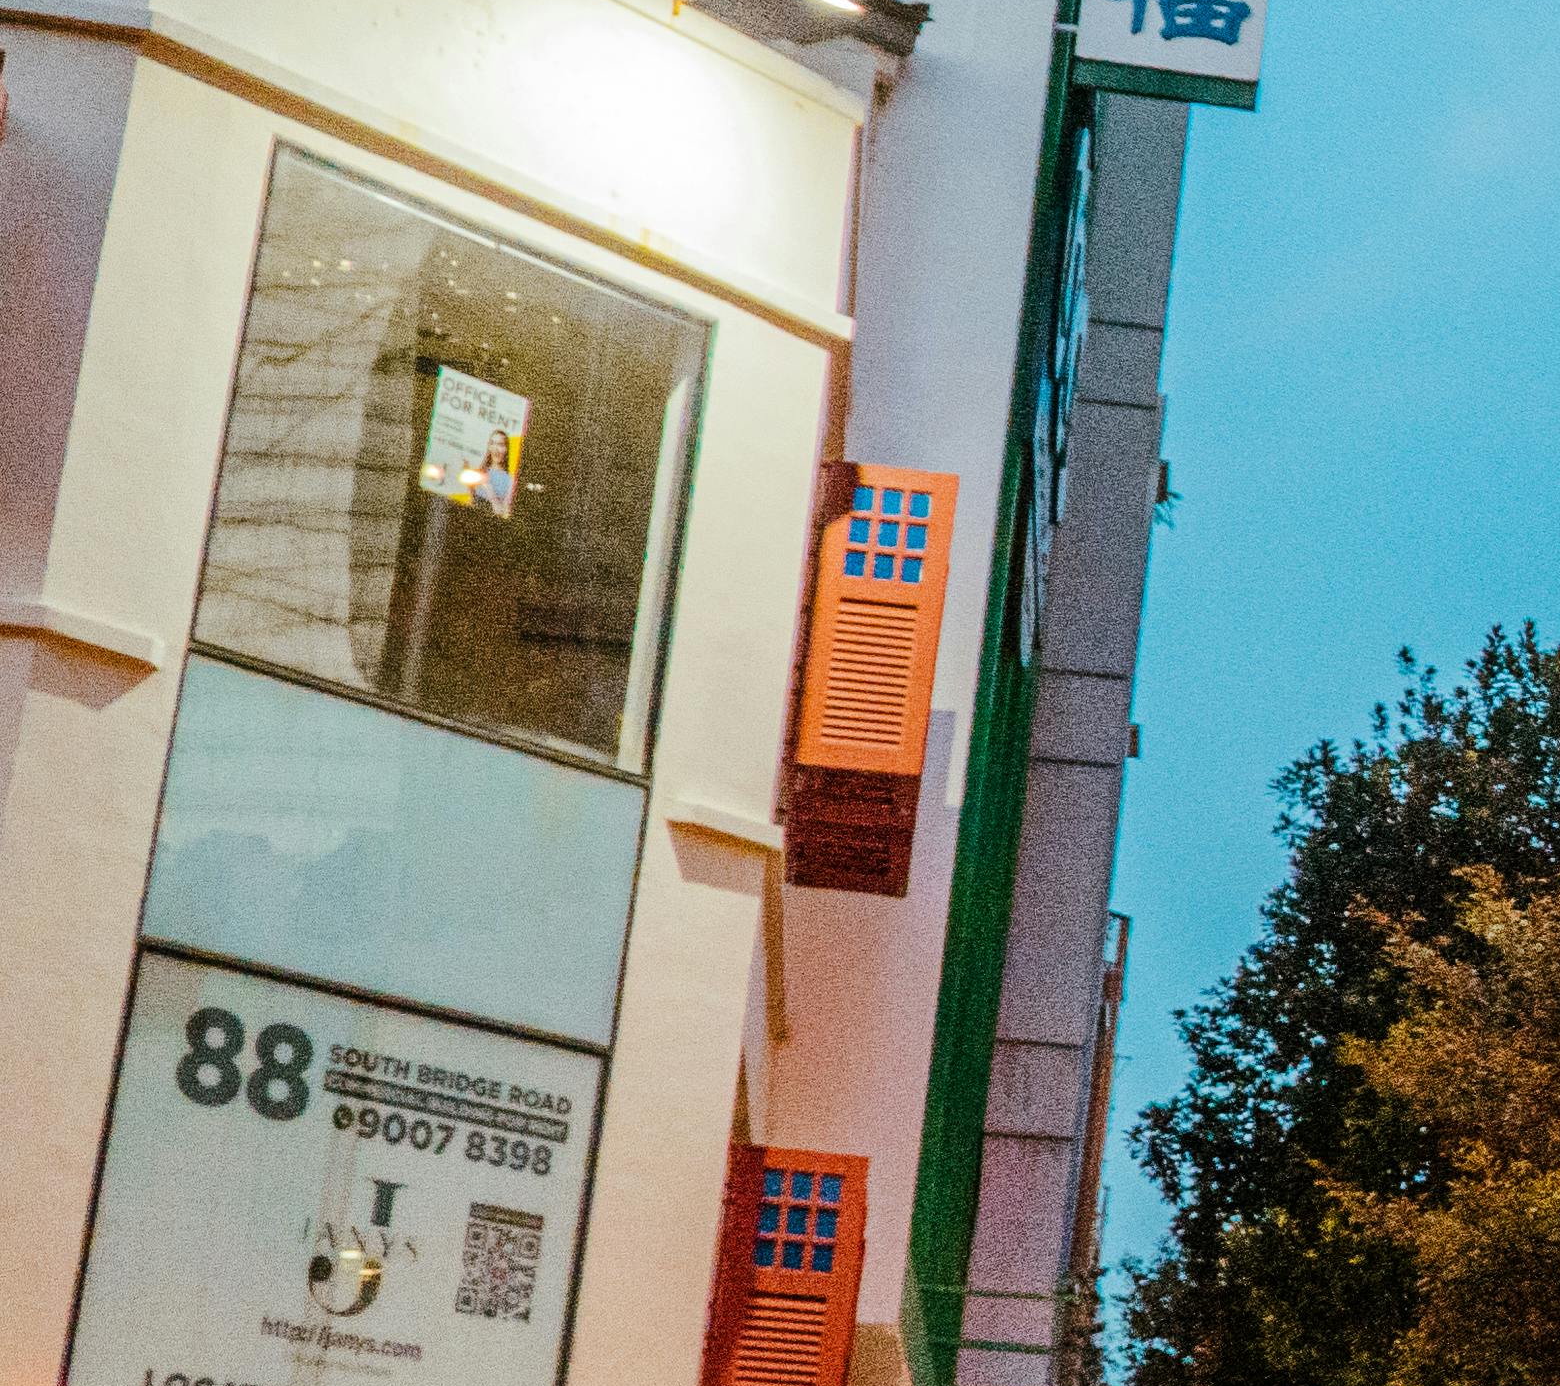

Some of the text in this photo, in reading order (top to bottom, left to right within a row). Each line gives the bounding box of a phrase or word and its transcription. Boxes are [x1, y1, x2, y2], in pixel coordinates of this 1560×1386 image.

[440, 392, 473, 413] FOR
[477, 408, 519, 432] RENT
[443, 377, 497, 409] OFFICE
[175, 1007, 313, 1121] 88
[328, 1044, 573, 1116] SOUTH BRIDGE ROAD
[464, 1129, 553, 1176] 8398
